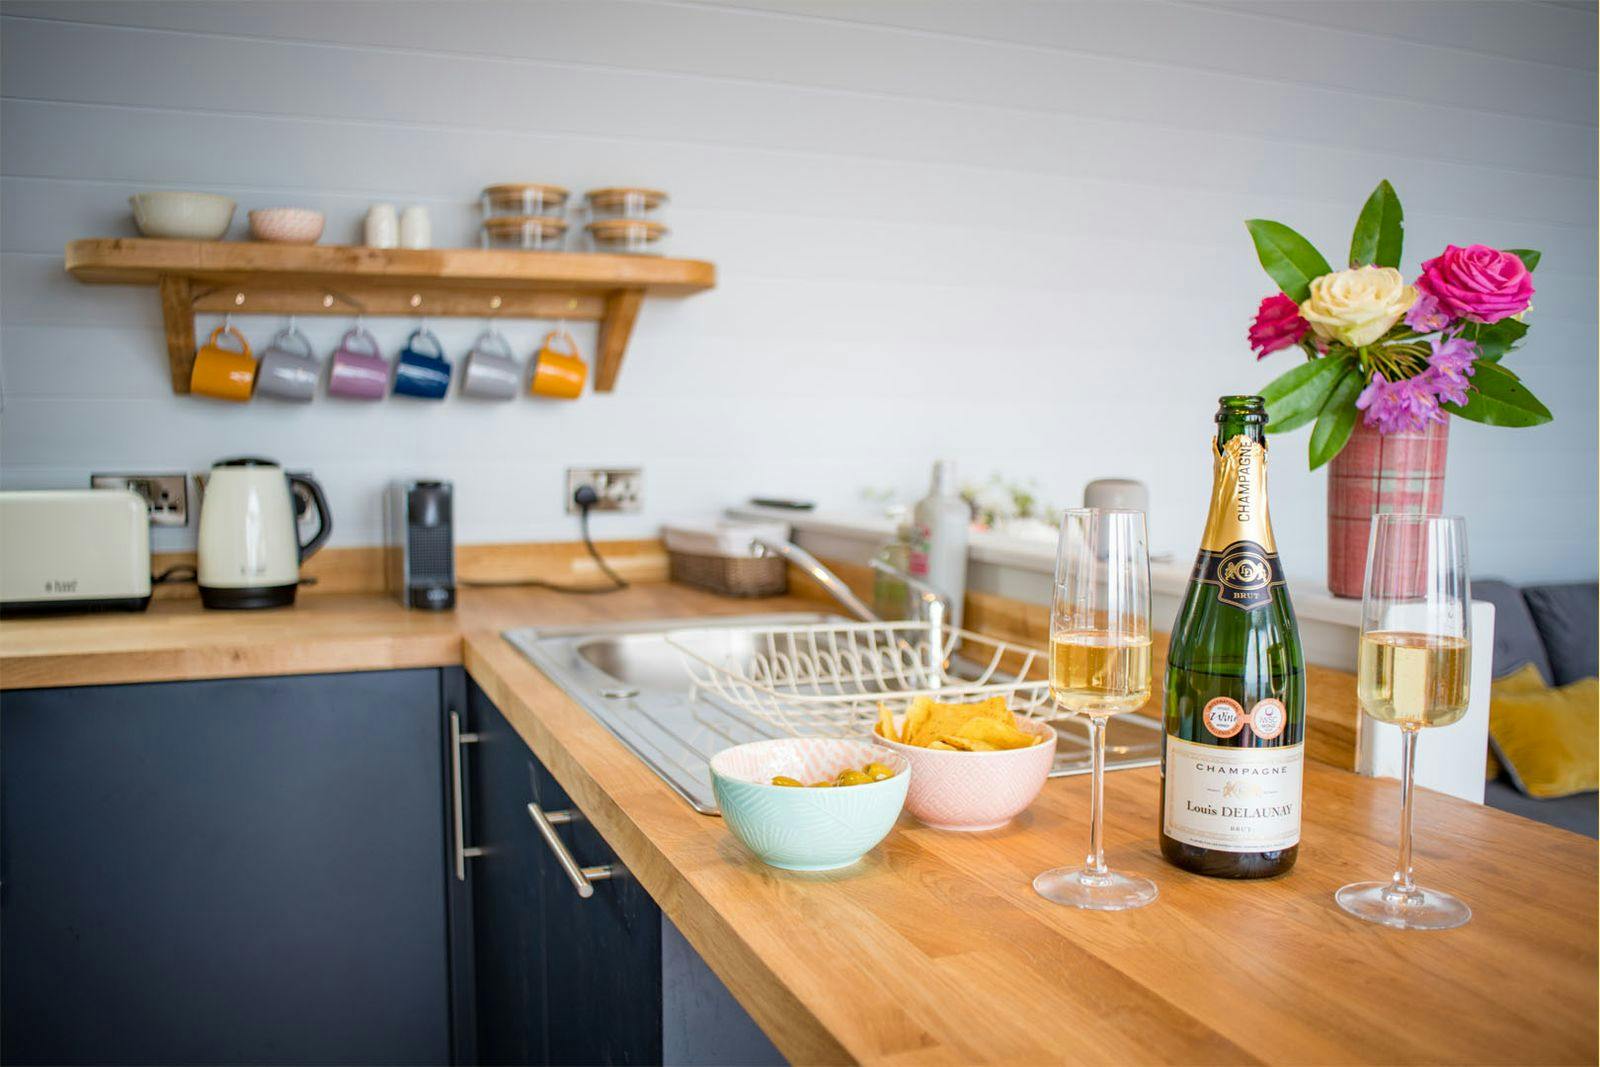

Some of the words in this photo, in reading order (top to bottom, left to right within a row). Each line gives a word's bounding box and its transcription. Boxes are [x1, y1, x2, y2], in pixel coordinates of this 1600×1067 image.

[1237, 440, 1252, 522] CHAMPAGNE
[1196, 763, 1287, 775] CHAMPAGNE
[1187, 800, 1217, 815] Louis
[1221, 803, 1293, 818] DELAUNAY
